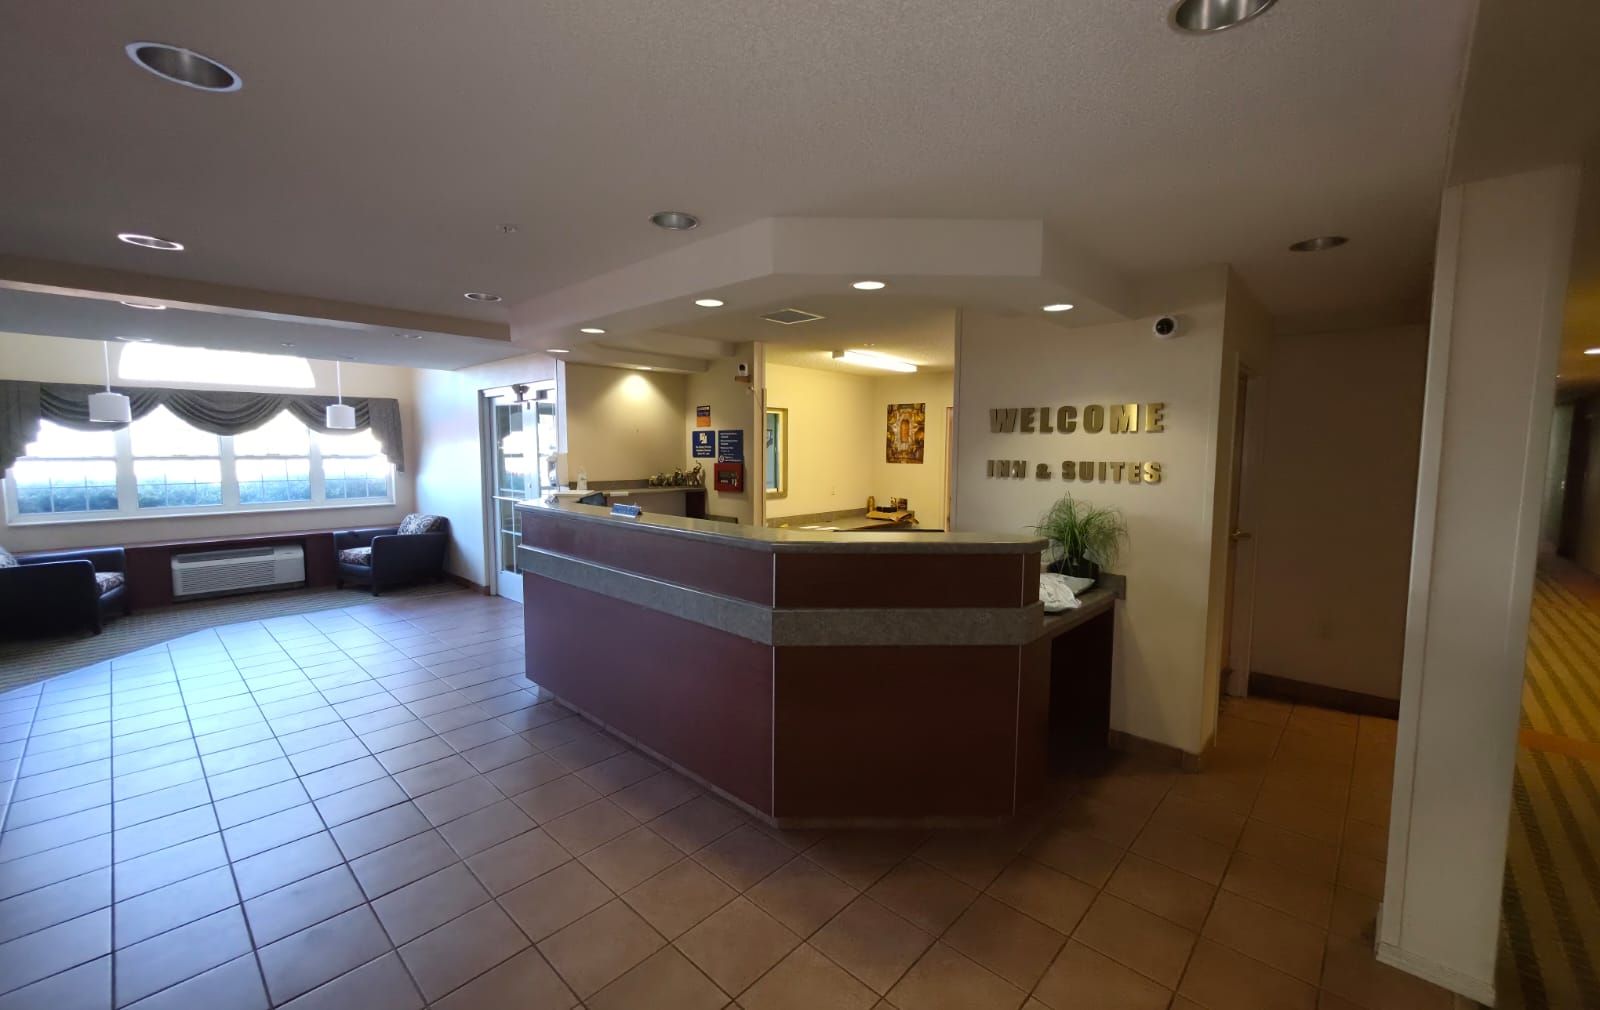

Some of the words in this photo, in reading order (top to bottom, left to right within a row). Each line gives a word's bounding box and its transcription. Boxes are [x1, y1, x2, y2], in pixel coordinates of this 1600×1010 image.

[989, 403, 1164, 433] WELCOME
[987, 460, 1027, 479] INN
[1036, 463, 1051, 480] &
[1062, 461, 1161, 484] SUITES
